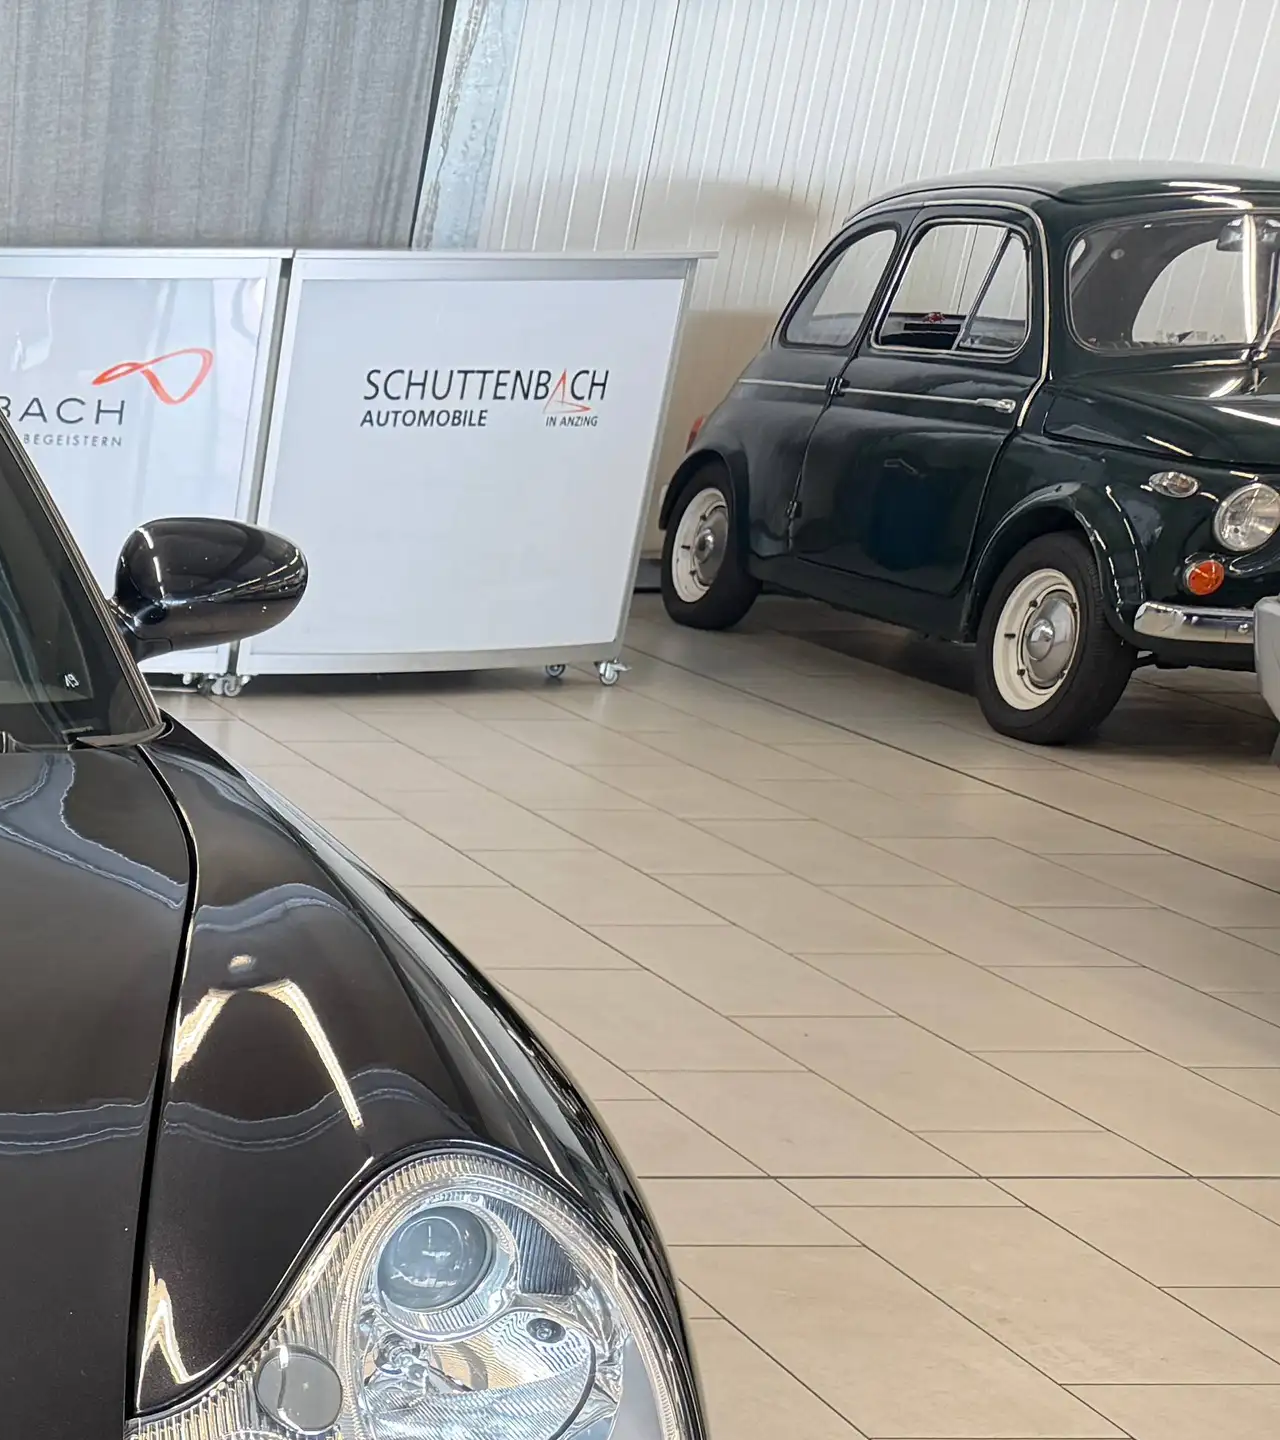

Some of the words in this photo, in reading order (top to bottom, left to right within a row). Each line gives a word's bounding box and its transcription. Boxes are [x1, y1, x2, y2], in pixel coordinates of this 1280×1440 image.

[363, 368, 609, 413] SCHUTTENBACH
[360, 409, 488, 428] AUTOMOBILE
[545, 415, 557, 427] IN
[559, 415, 599, 427] ANZING
[23, 433, 123, 447] BEGEISTERN
